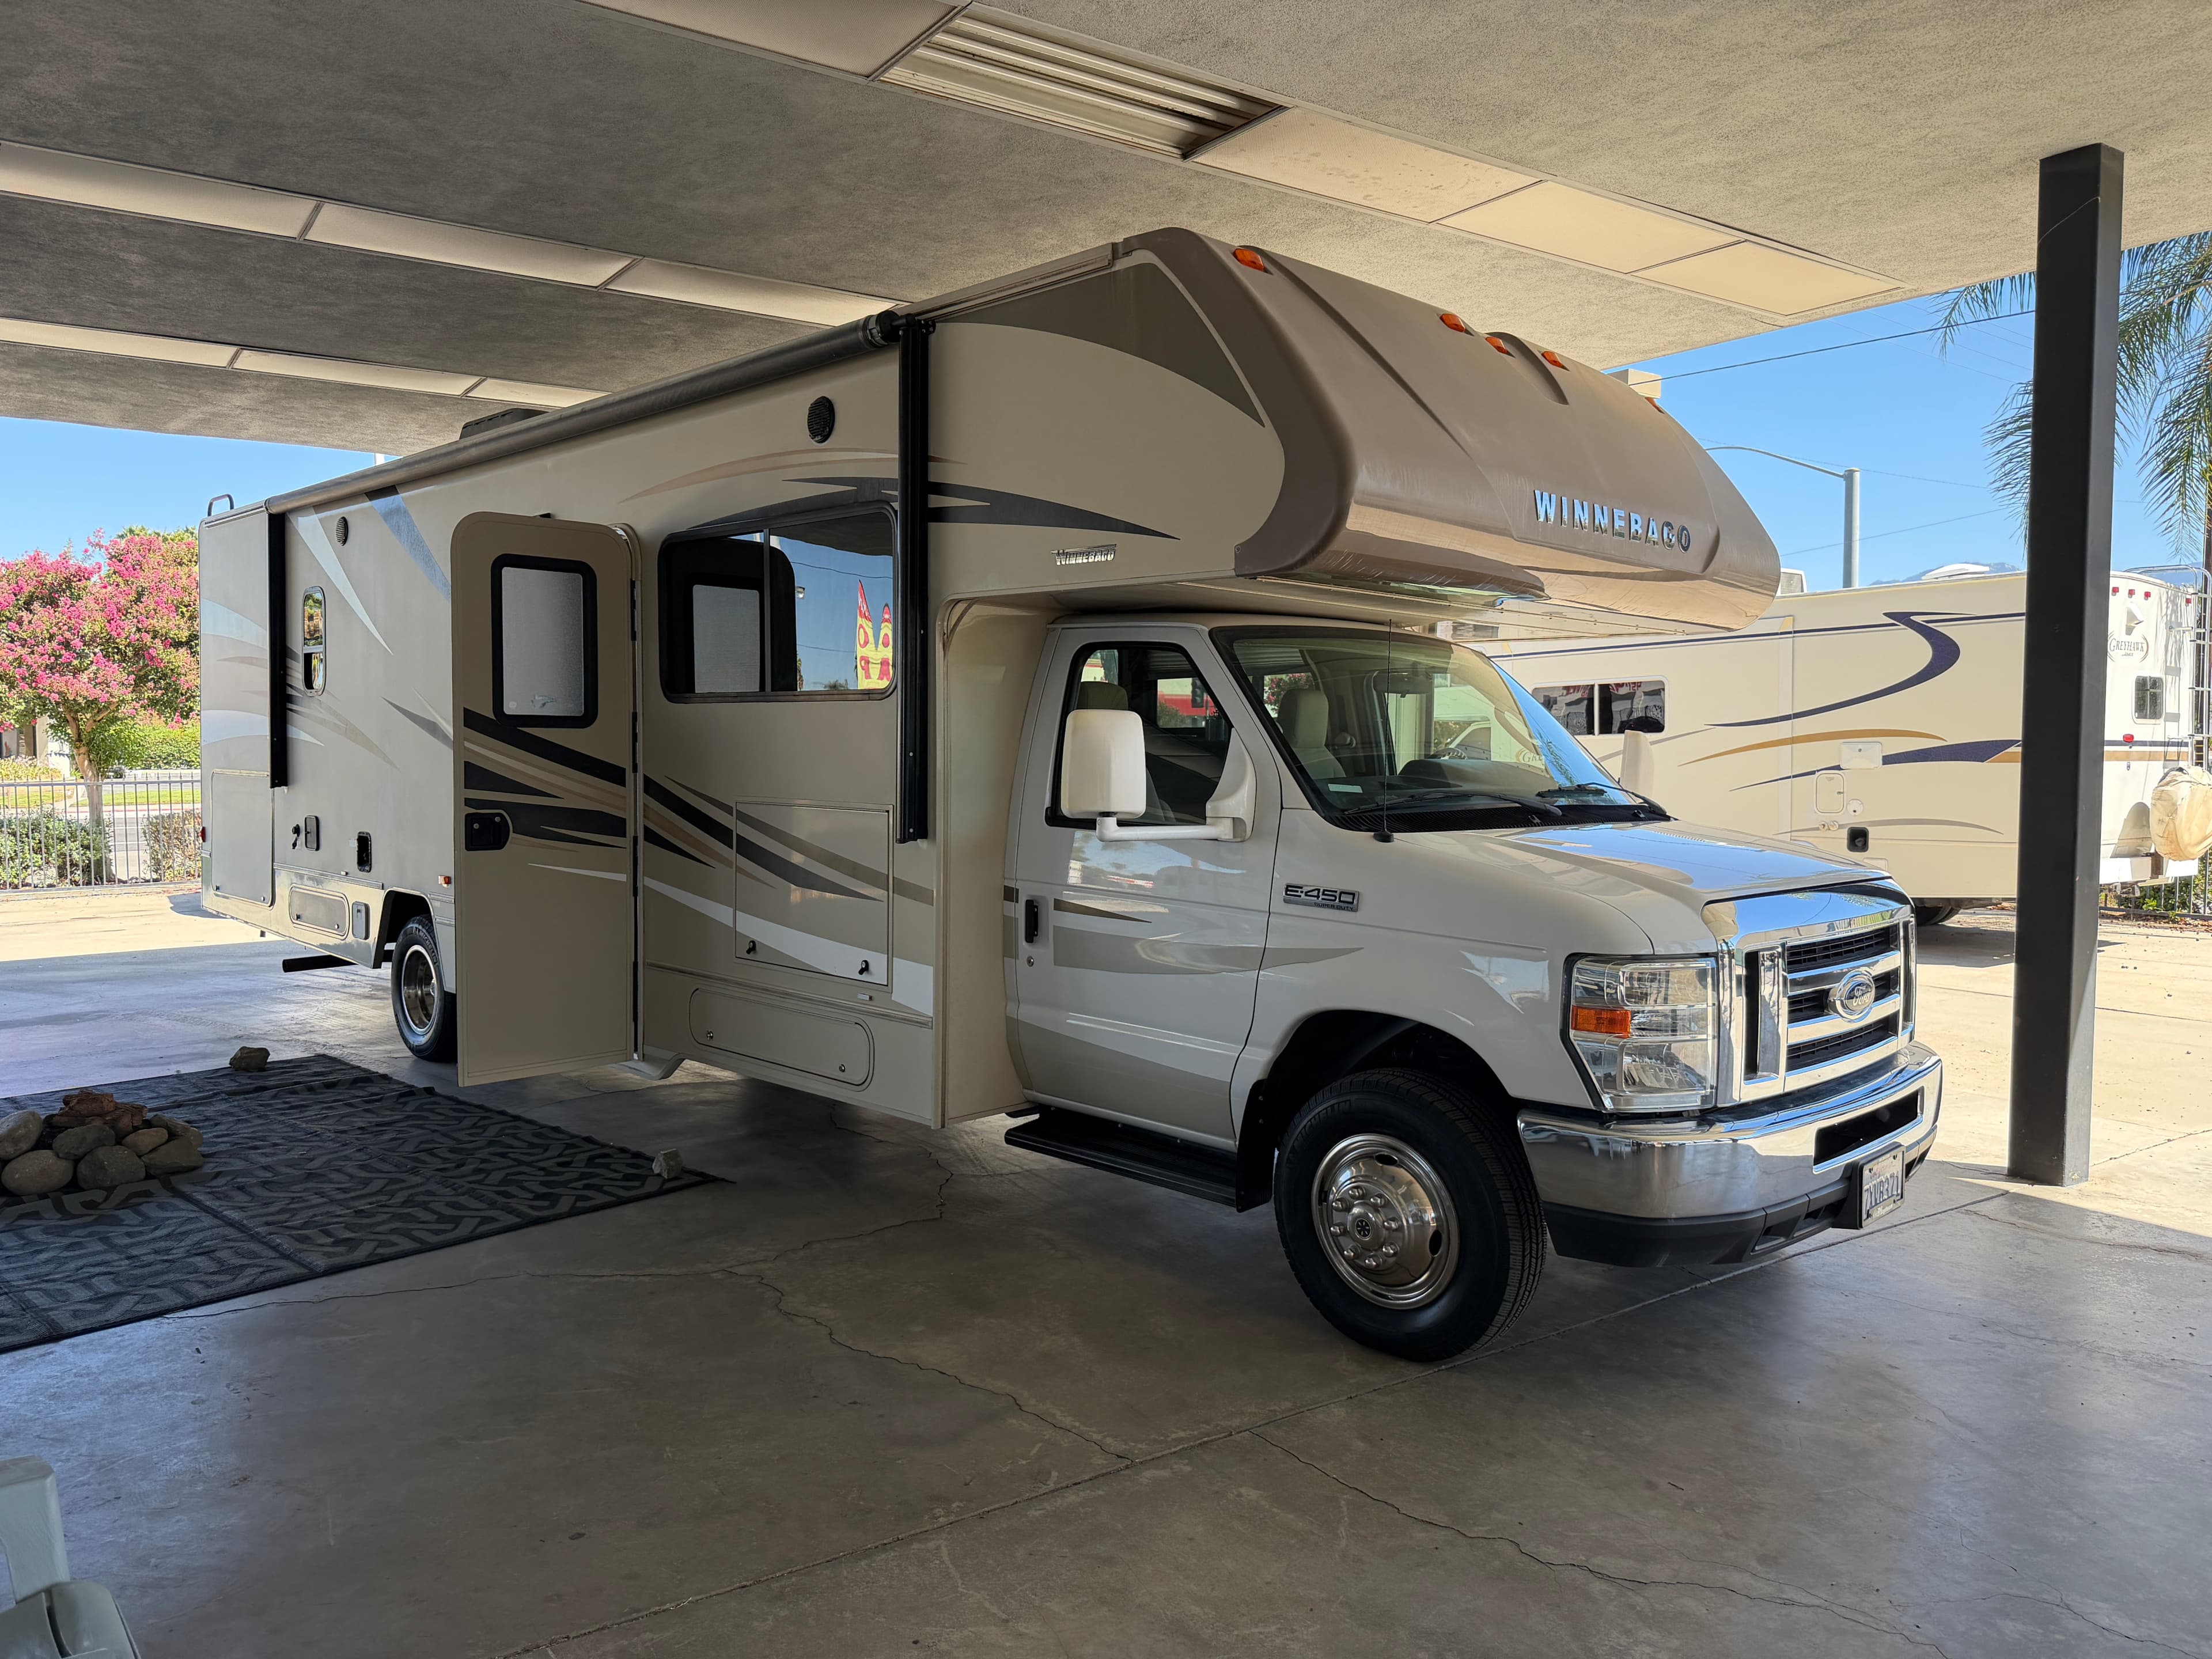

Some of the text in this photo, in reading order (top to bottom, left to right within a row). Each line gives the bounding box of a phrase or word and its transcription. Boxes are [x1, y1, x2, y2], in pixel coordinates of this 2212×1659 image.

[1534, 489, 1691, 553] WINNEBAGO
[1055, 548, 1116, 566] WINNEBAGO
[2109, 637, 2145, 652] GREYHAWK
[1285, 884, 1356, 904] E-450
[1853, 986, 1870, 1006] Ford
